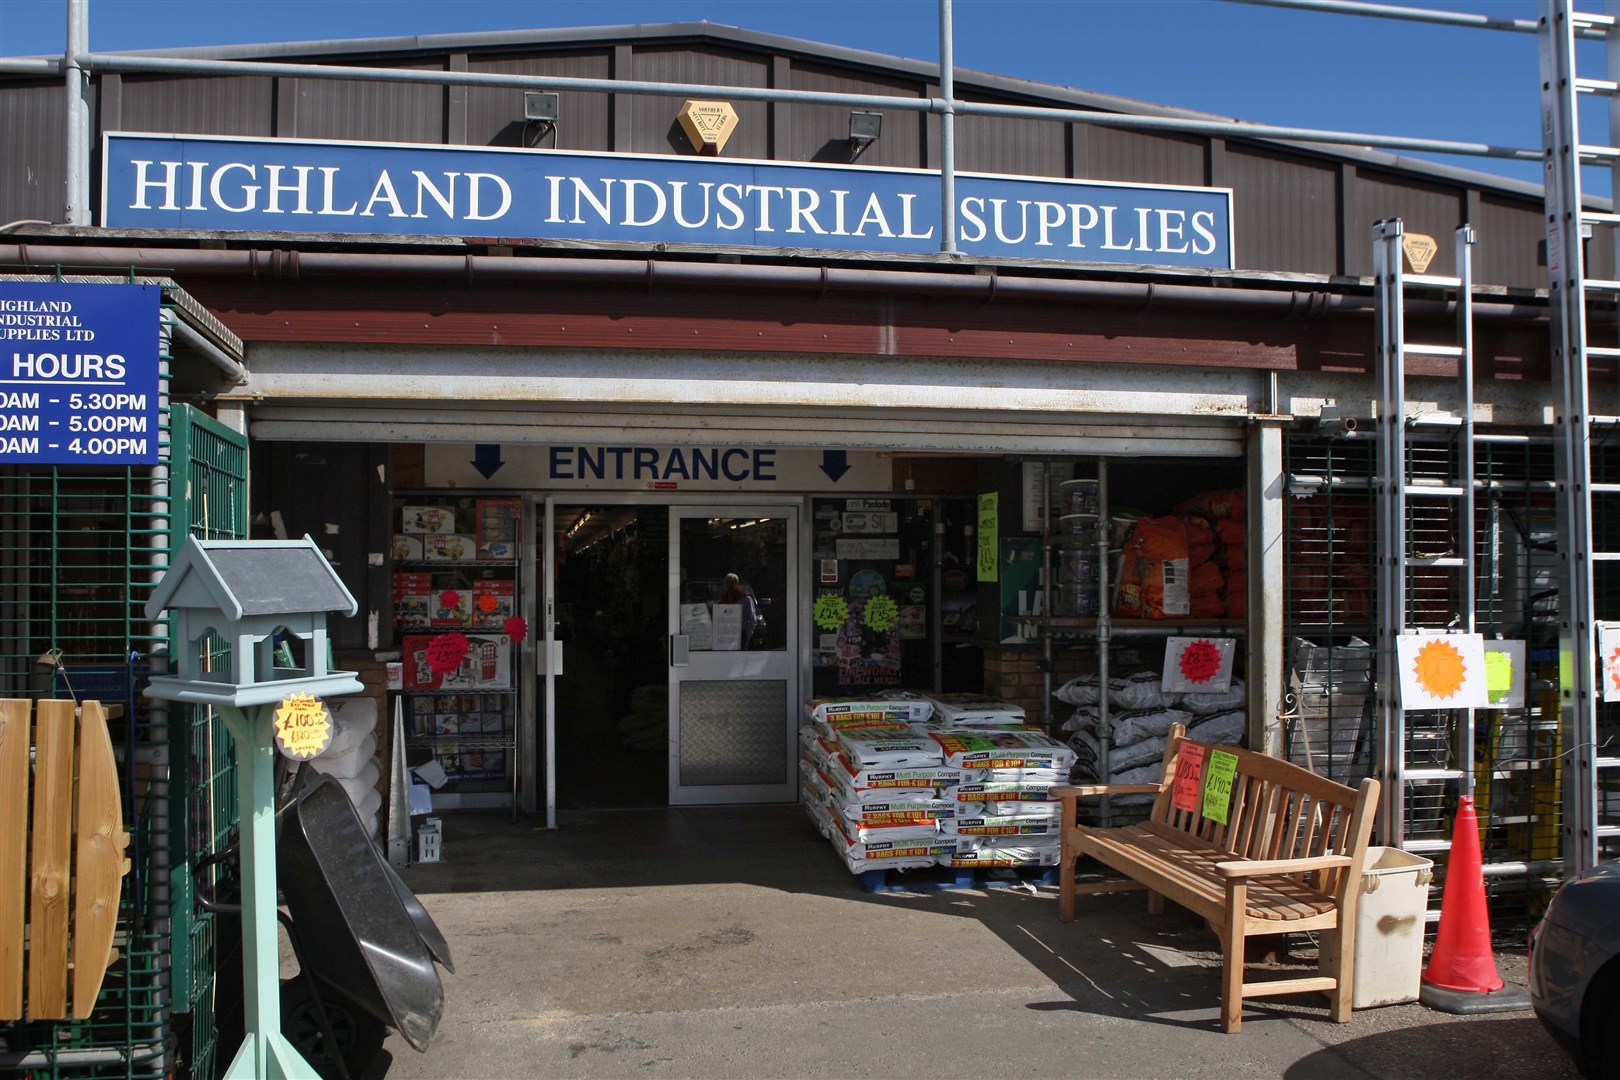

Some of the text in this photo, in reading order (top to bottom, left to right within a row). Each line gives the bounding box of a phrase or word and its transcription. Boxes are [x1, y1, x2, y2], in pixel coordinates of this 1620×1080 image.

[130, 160, 1216, 254] HIGHLAND INDUSTRIAL SUPPLIES
[66, 330, 95, 342] LTD
[13, 354, 126, 379] HOURS
[69, 393, 146, 410] 5.30PM
[69, 416, 147, 432] 5.00PM
[68, 438, 147, 454] 4.00PM
[550, 446, 777, 482] ENTRANCE
[863, 500, 890, 508] Paslode
[839, 665, 897, 676] FIREWORKS
[839, 676, 850, 684] ON
[854, 676, 872, 684] SALE
